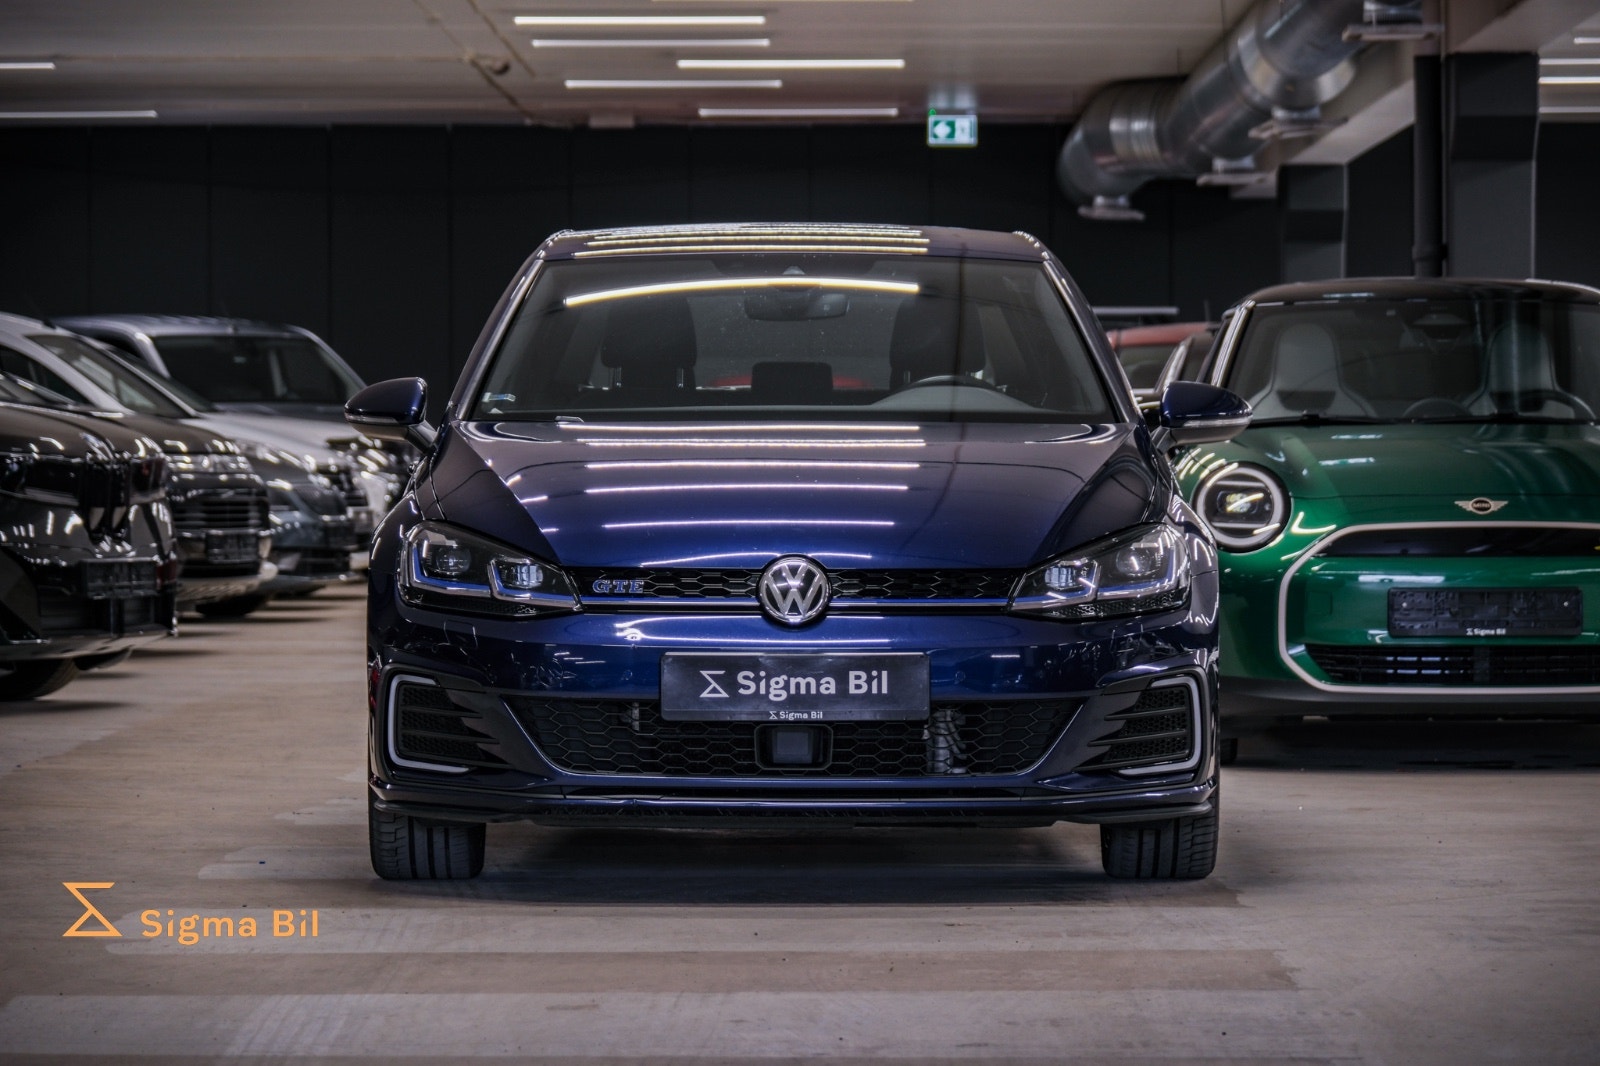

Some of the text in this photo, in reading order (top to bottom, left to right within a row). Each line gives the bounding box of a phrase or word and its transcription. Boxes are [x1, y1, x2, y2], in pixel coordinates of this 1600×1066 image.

[592, 579, 645, 593] GTE
[736, 670, 889, 701] Sigma Bil
[779, 711, 823, 720] Sigma Bil
